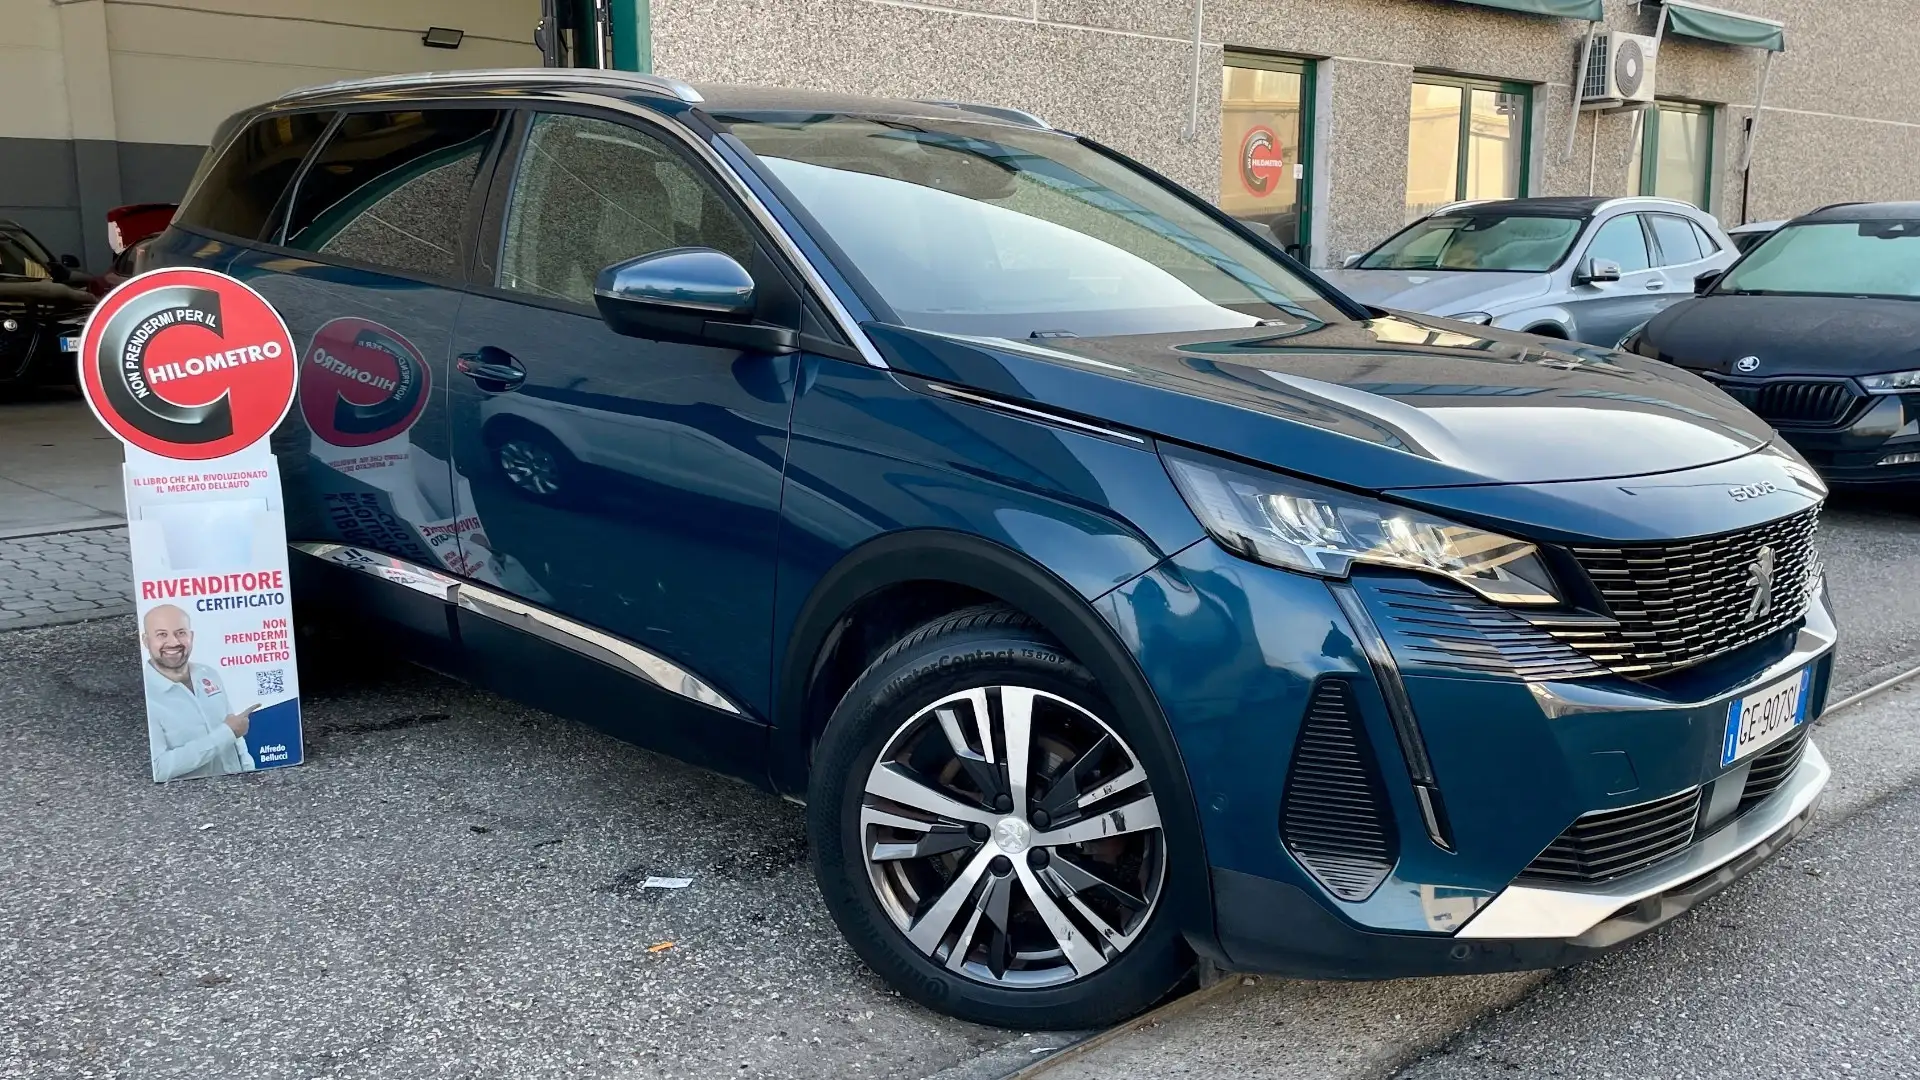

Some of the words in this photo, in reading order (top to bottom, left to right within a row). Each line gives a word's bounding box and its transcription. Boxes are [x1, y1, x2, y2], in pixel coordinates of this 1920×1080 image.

[176, 309, 204, 322] PER
[205, 313, 217, 328] IL
[126, 311, 175, 369] PRENDERMI
[148, 341, 282, 385] HILOMETRO
[128, 371, 150, 399] NON
[143, 477, 168, 486] LIBRO
[170, 475, 185, 484] CHE
[203, 470, 268, 482] RIVOLUZIONATO
[168, 483, 206, 492] MERCATO
[208, 480, 249, 490] DELL'AUTO
[1728, 479, 1777, 502] 5008
[142, 570, 283, 600] RIVENDITORE
[196, 592, 284, 612] CERTIFICATO
[263, 618, 287, 629] NON
[224, 630, 287, 644] PRENDERMI
[257, 642, 277, 652] PER
[280, 640, 289, 649] IL
[220, 650, 290, 667] CHILOMETRO
[883, 648, 1014, 698] WinterContact
[1021, 648, 1034, 658] TS
[1036, 650, 1056, 663] 870
[260, 744, 286, 754] Alfredo
[260, 752, 288, 762] Bellucci
